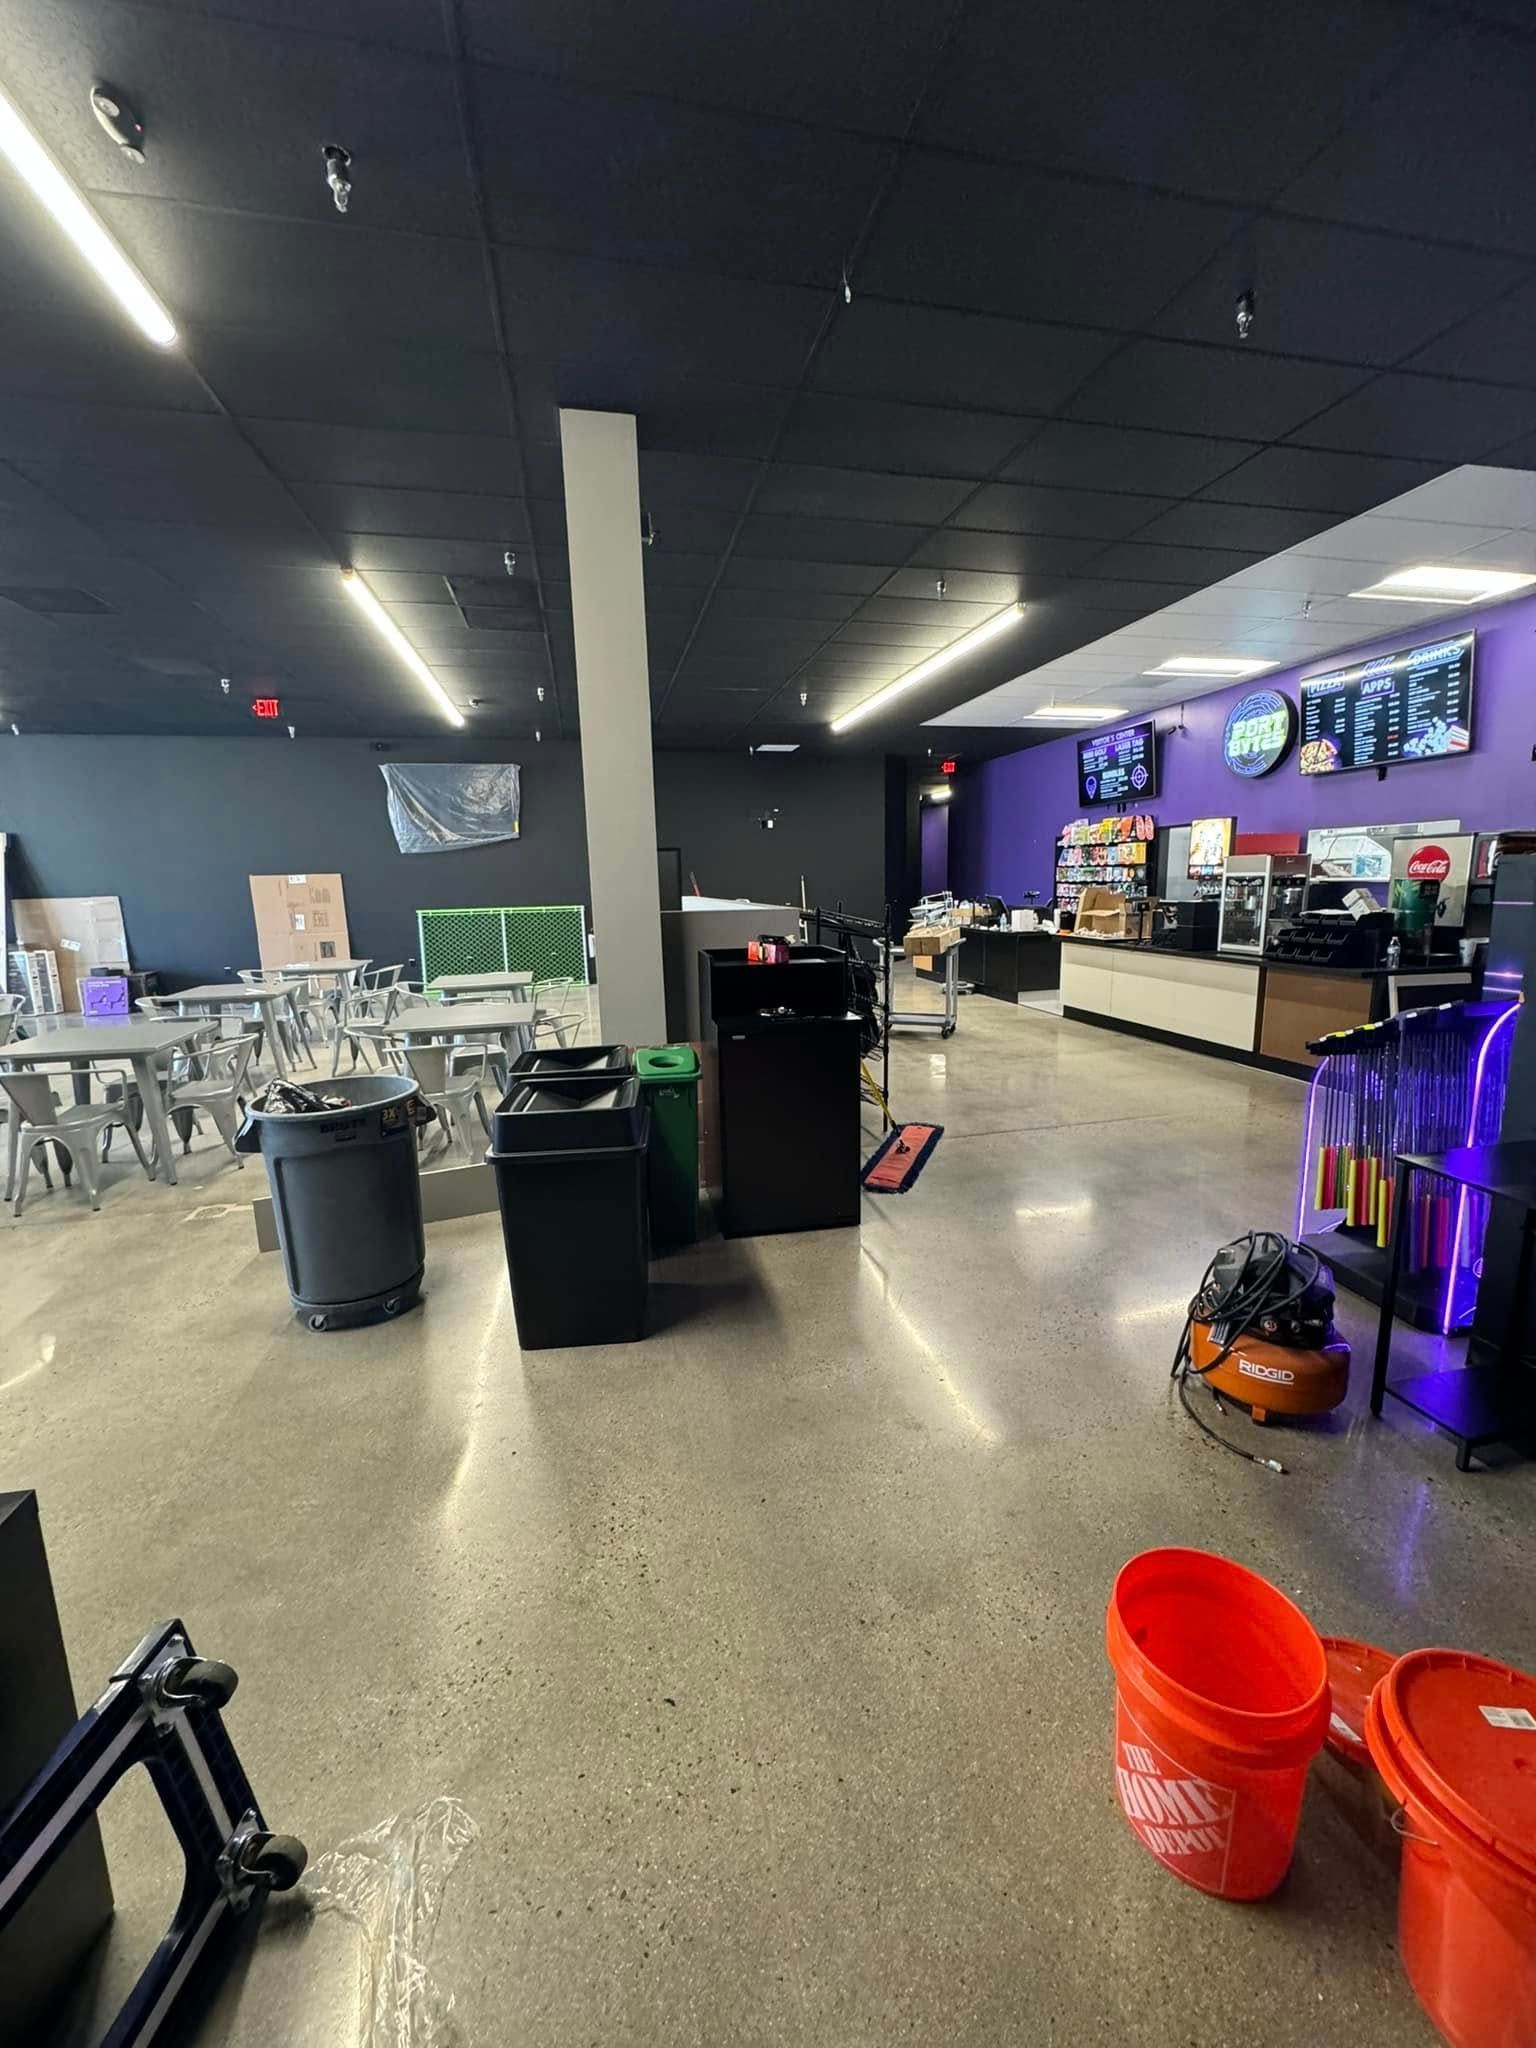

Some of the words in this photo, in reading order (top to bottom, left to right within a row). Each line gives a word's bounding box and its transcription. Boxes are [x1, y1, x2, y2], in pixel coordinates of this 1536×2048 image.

[1310, 680, 1342, 694] PIZZA
[1362, 677, 1392, 695] APPS
[256, 699, 279, 717] EXIT
[1239, 1359, 1295, 1381] RIDGID
